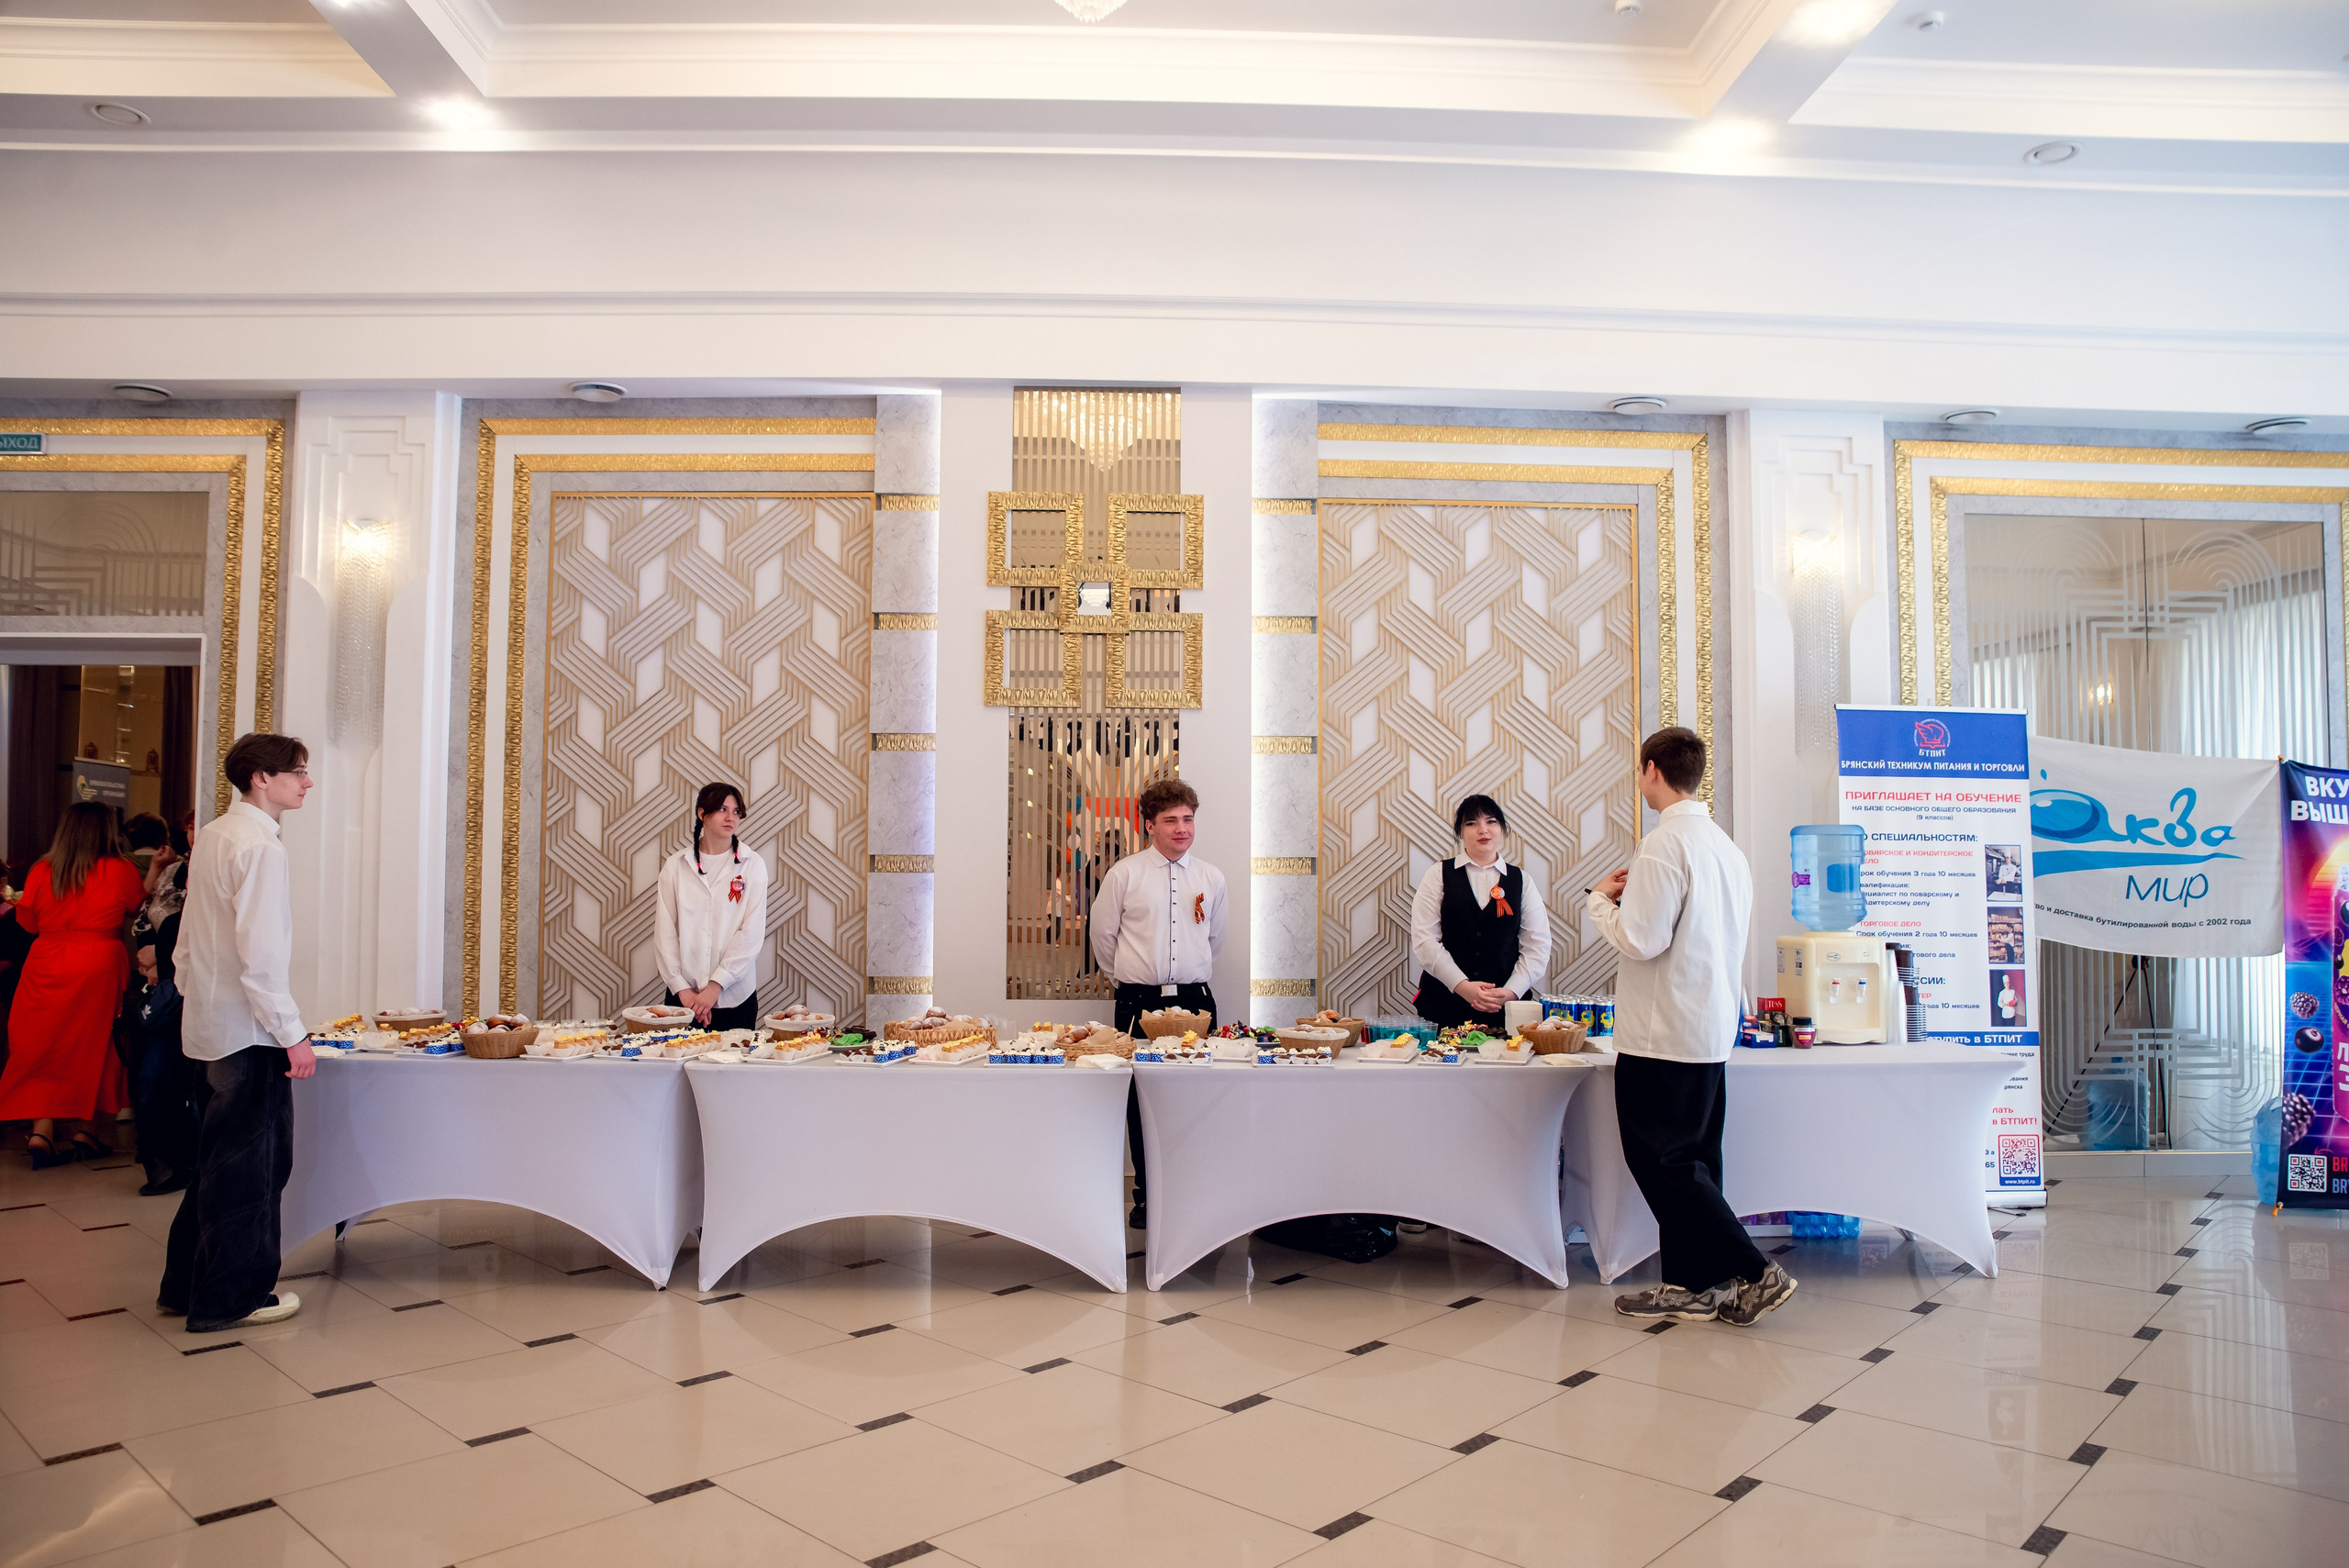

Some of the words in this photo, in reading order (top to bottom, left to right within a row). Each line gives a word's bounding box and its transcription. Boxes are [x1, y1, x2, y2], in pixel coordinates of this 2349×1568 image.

[1919, 749, 1946, 757] БТПИТ
[1841, 760, 1886, 769] БРЯНСКИЙ
[1887, 761, 1932, 770] ТЕХНИКУМ
[1933, 762, 1972, 771] ПИТАНИЯ
[1981, 763, 2025, 772] ТОРГОВЛИ
[1845, 791, 1932, 801] ПРИГЛАШАЕТ
[1935, 792, 1952, 802] НА
[1955, 793, 2022, 803] ОБУЧЕНИЕ
[1871, 833, 1978, 842] СПЕЦИАЛЬНОСТЯМ:
[2054, 907, 2093, 921] доставка
[2096, 917, 2168, 929] бутилированной
[1984, 1034, 2023, 1043] БТПИТ
[2000, 1118, 2038, 1126] БТПИТ!
